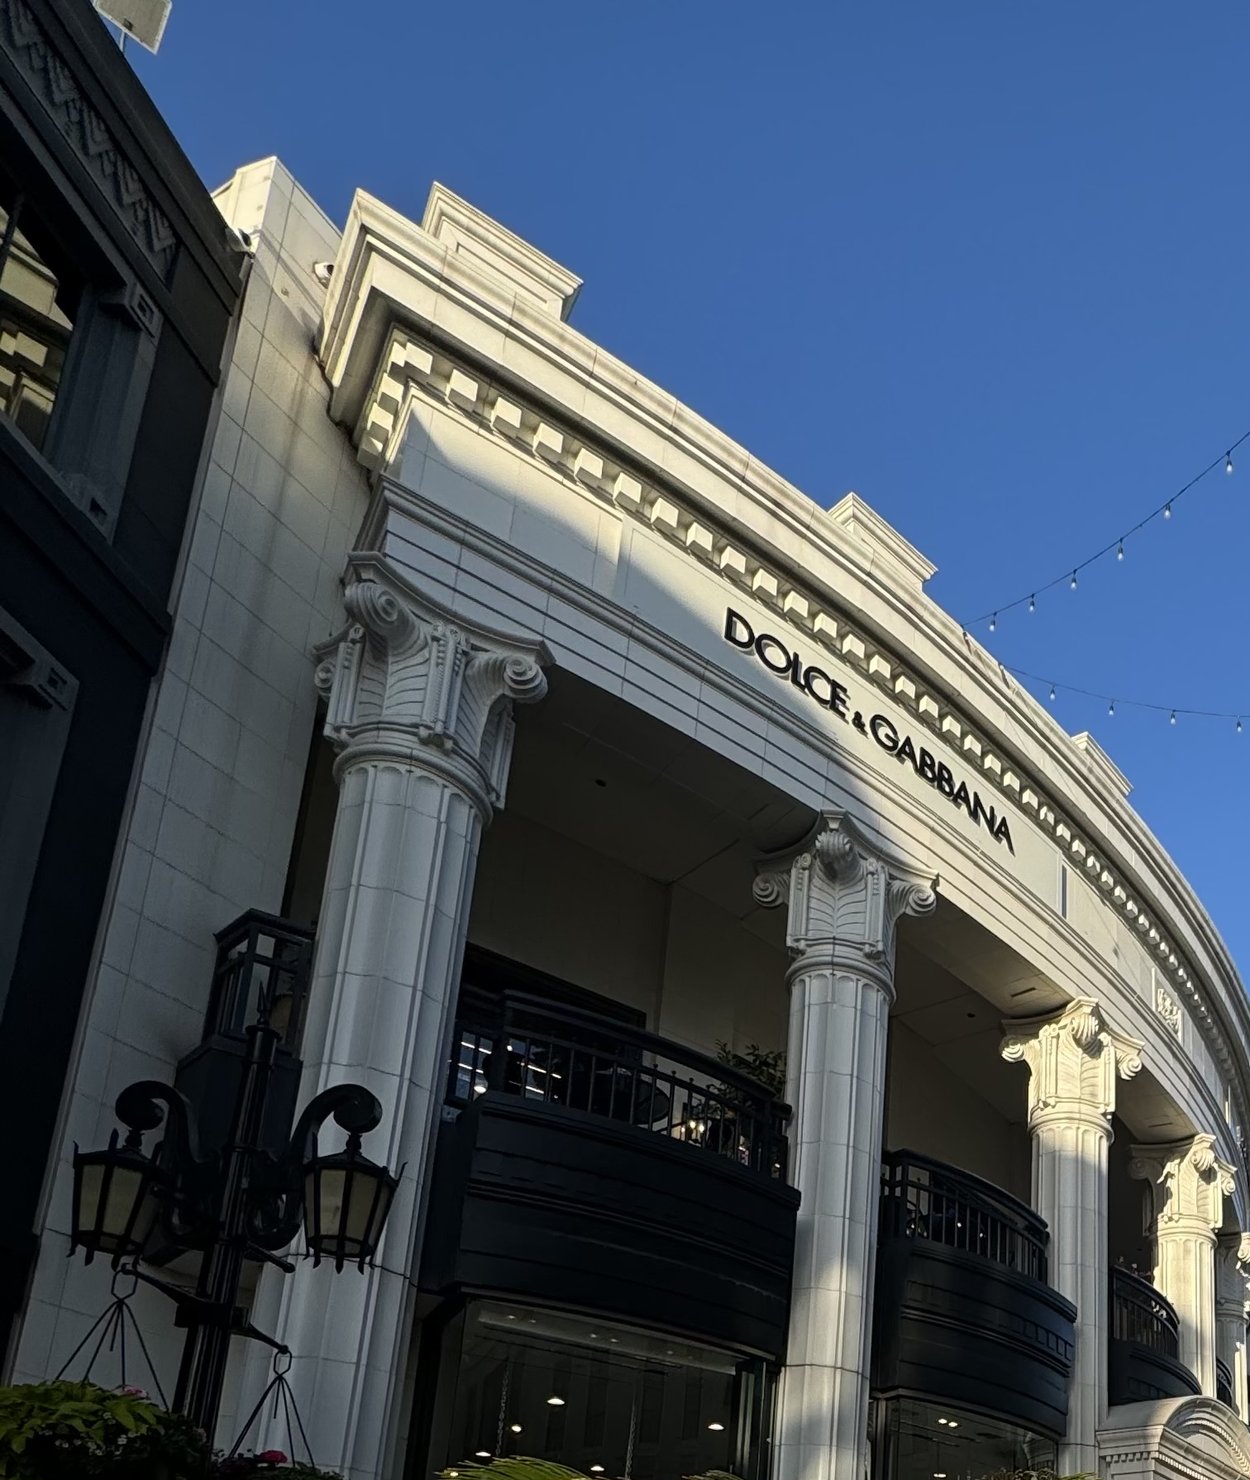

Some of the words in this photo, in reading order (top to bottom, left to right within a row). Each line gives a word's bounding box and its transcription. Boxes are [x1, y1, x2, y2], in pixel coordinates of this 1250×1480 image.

[724, 607, 848, 722] DOLCE
[851, 711, 867, 733] &
[870, 714, 1016, 857] GABBANA
